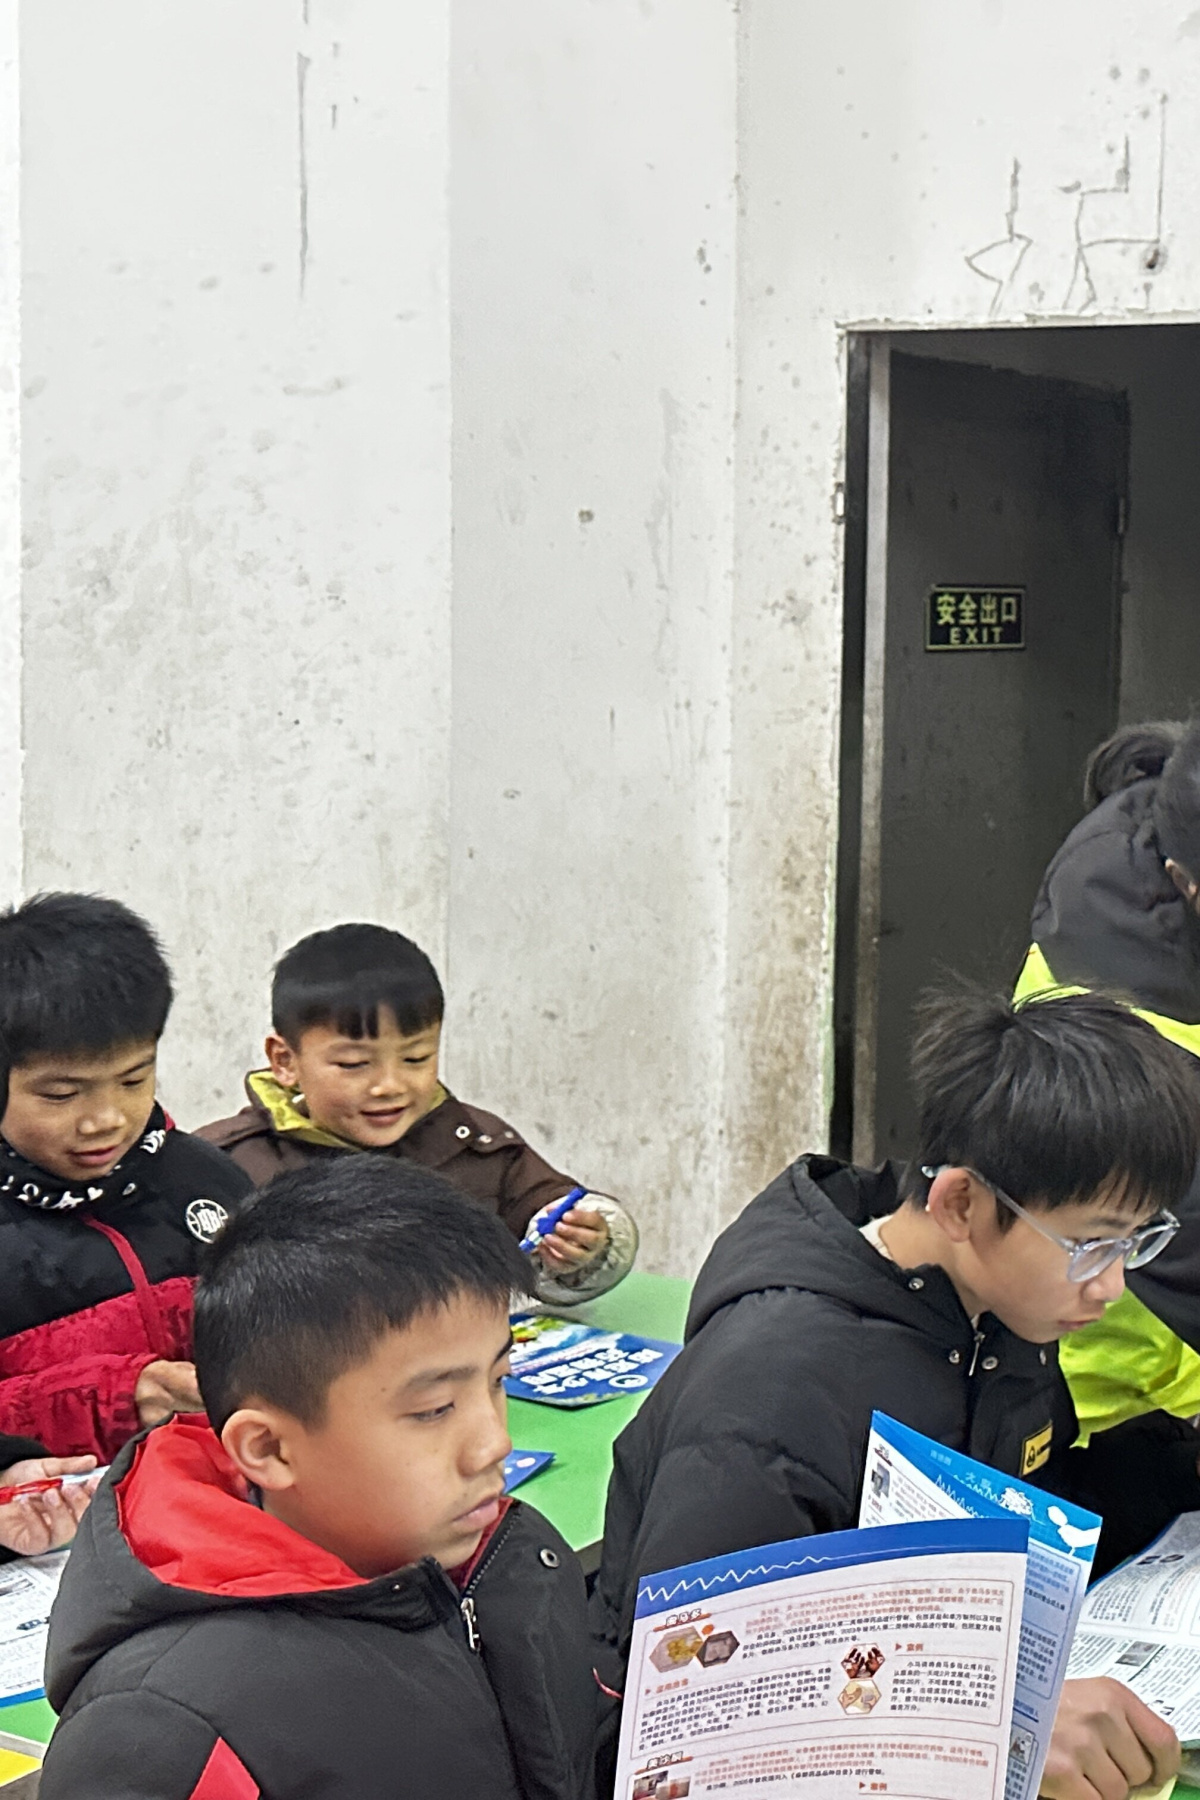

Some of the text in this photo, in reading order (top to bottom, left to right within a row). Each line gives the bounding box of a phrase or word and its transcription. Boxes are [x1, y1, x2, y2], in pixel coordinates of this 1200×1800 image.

[937, 593, 1017, 625] 安全出口
[950, 626, 1004, 645] EXIT
